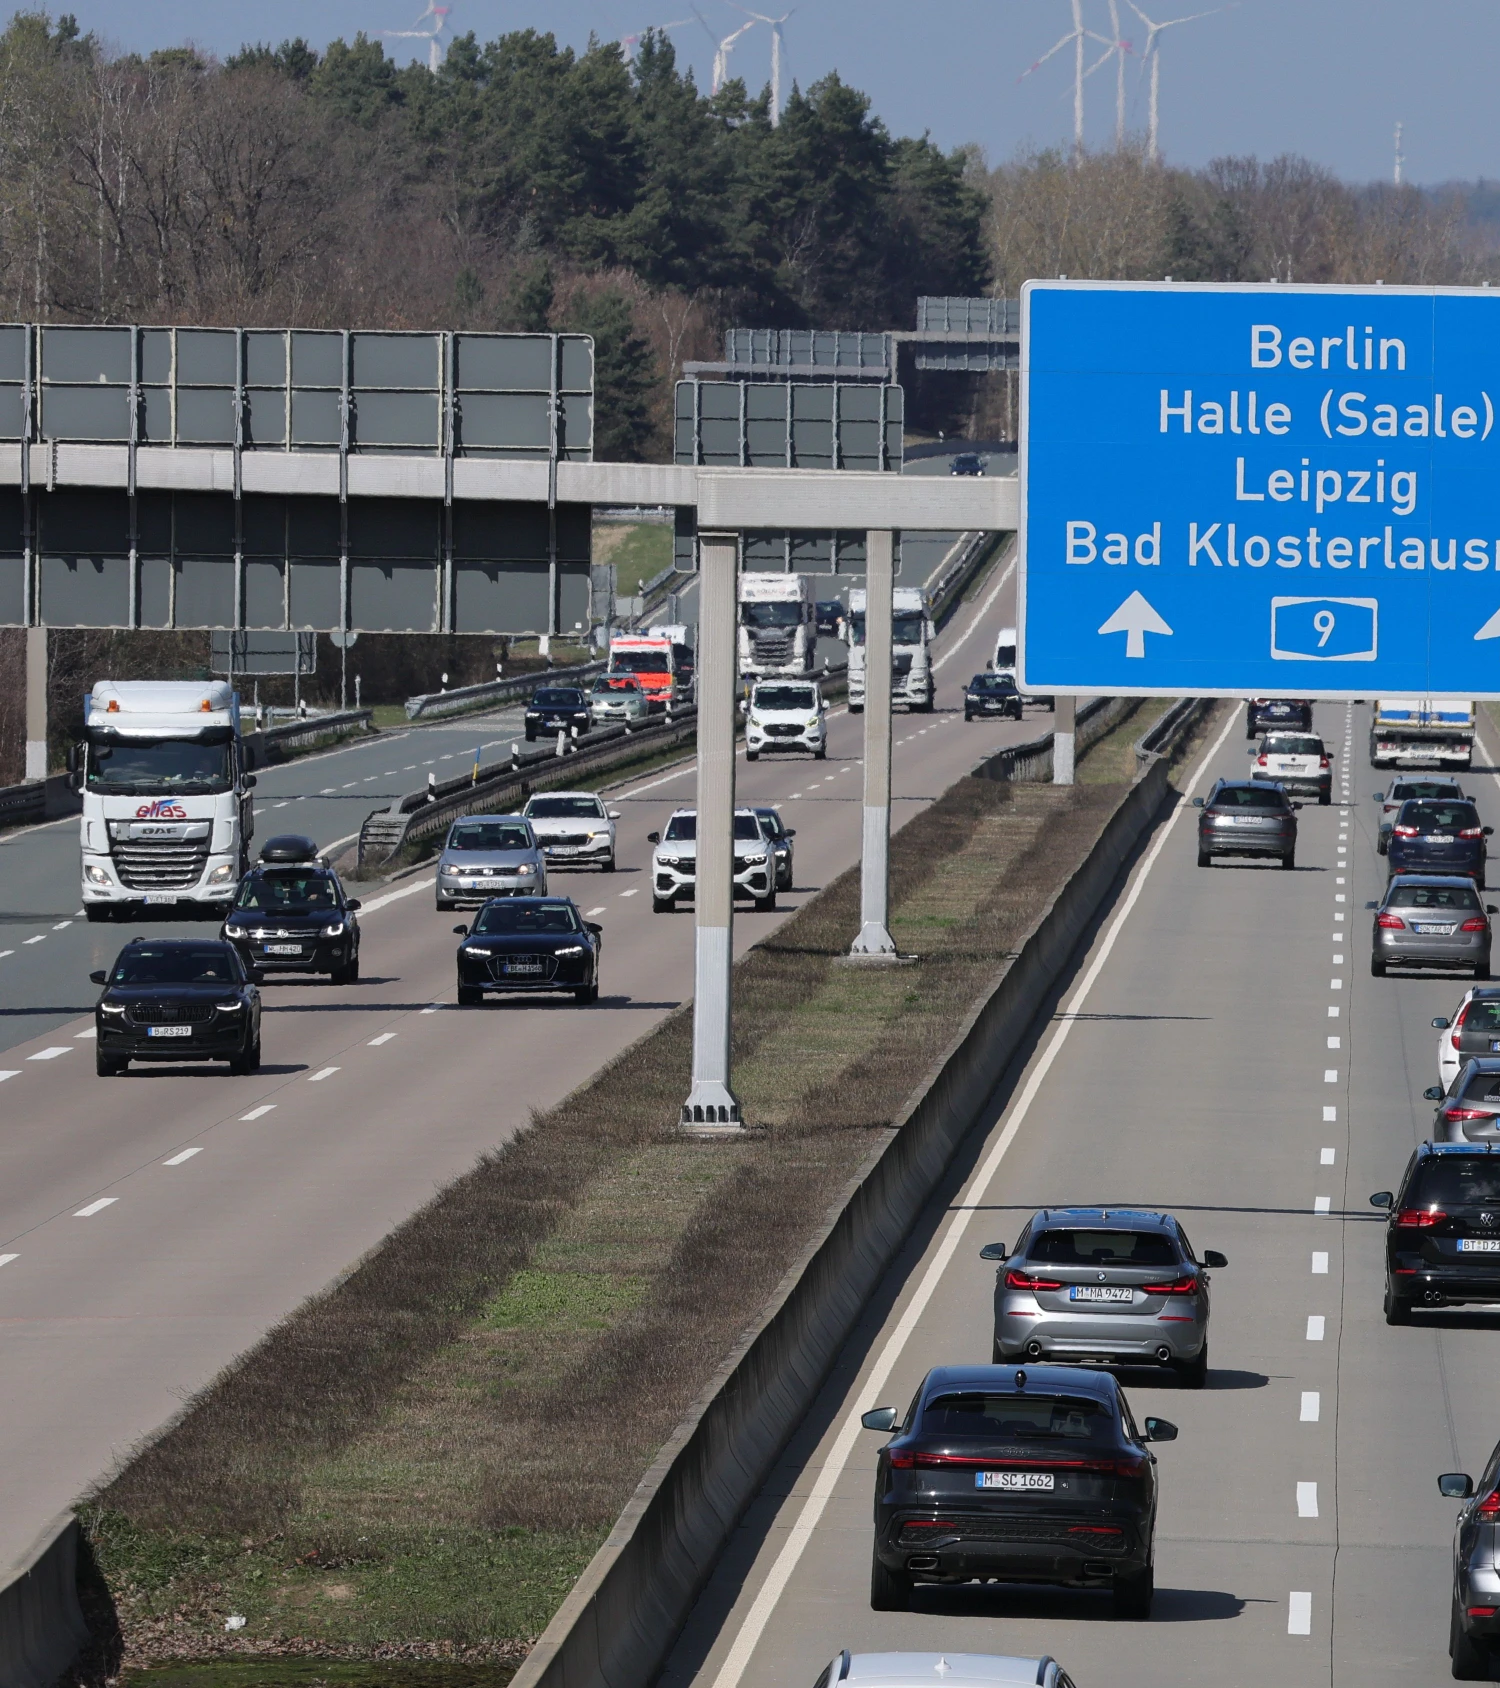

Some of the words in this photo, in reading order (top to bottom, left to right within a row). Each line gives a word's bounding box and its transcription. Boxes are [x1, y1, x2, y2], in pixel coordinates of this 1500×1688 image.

[1252, 325, 1405, 369] Berlin
[1161, 390, 1290, 434] Halle
[1321, 390, 1493, 440] (Saale)
[1237, 458, 1416, 515] Leipzig
[1067, 522, 1160, 565] Bad
[1314, 611, 1334, 646] 9
[136, 800, 187, 818] elias
[1464, 1241, 1476, 1249] BT
[1483, 1241, 1488, 1250] D
[1076, 1287, 1083, 1297] M
[1090, 1288, 1103, 1298] MA
[1106, 1288, 1130, 1298] 9472
[985, 1473, 992, 1485] M
[1002, 1474, 1018, 1486] SC
[1021, 1474, 1052, 1487] 1662
